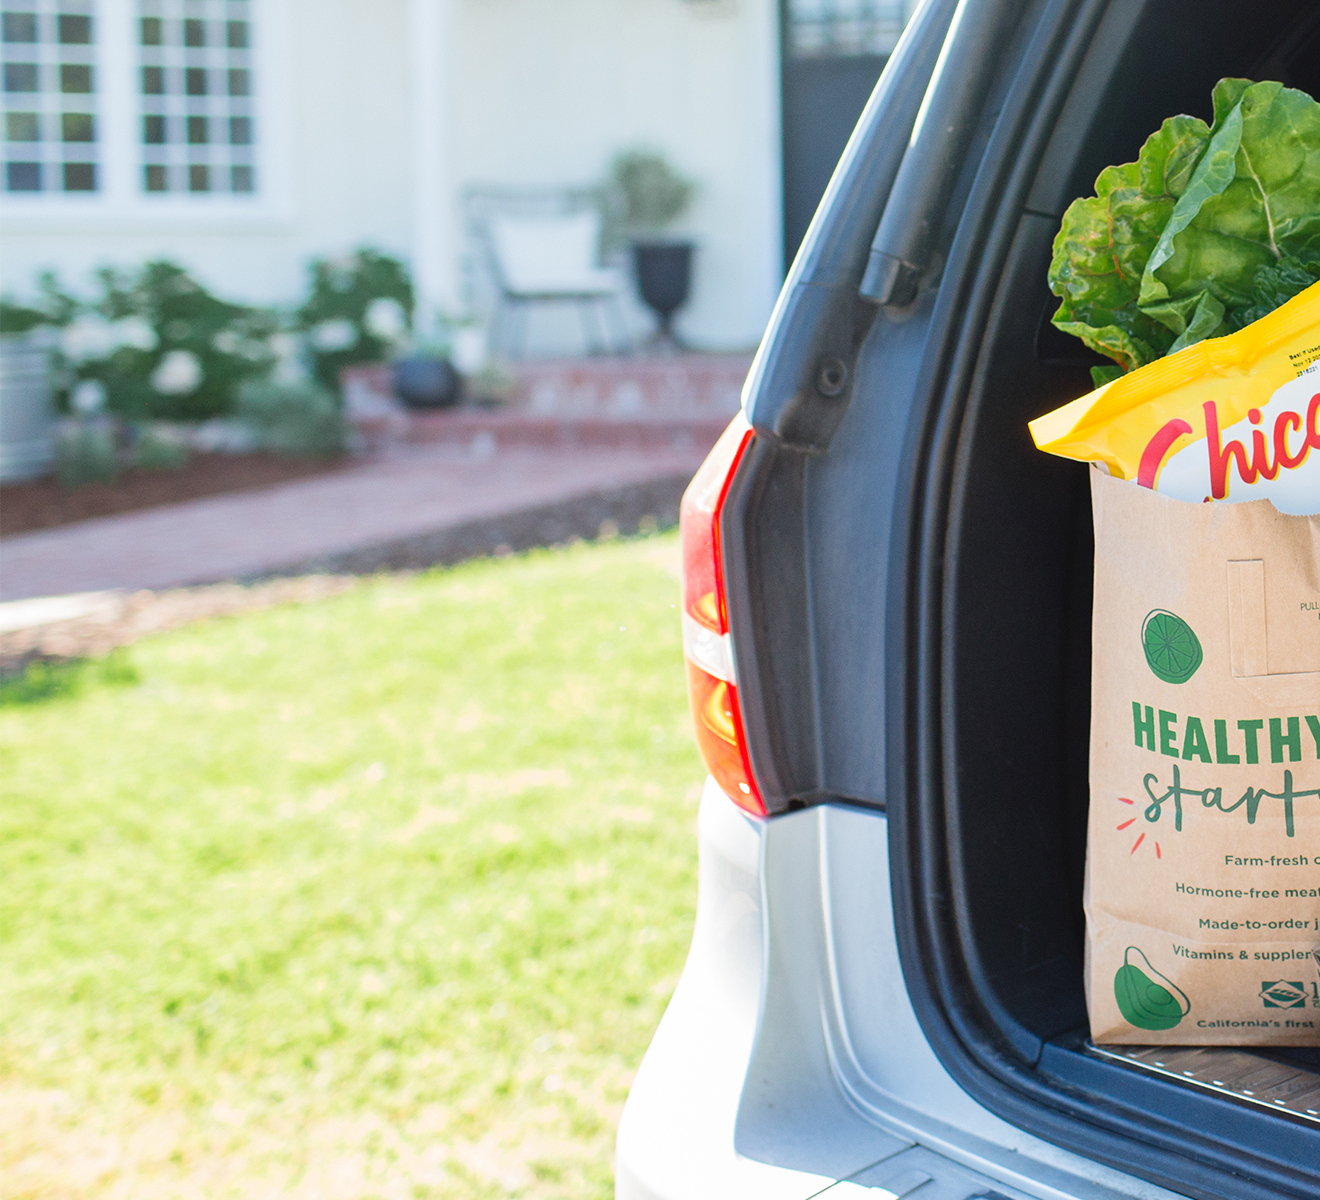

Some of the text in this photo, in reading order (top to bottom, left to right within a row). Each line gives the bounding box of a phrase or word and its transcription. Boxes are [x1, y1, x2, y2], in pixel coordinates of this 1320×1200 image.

[1300, 601, 1319, 611] PULL
[1224, 854, 1309, 867] Farm-fresh
[1175, 882, 1280, 899] Hormone-free
[1198, 918, 1310, 930] Made-to-order
[1172, 944, 1234, 960] Vitamins
[1238, 950, 1249, 960] &
[1196, 1019, 1281, 1029] California's
[1284, 1019, 1315, 1029] first
